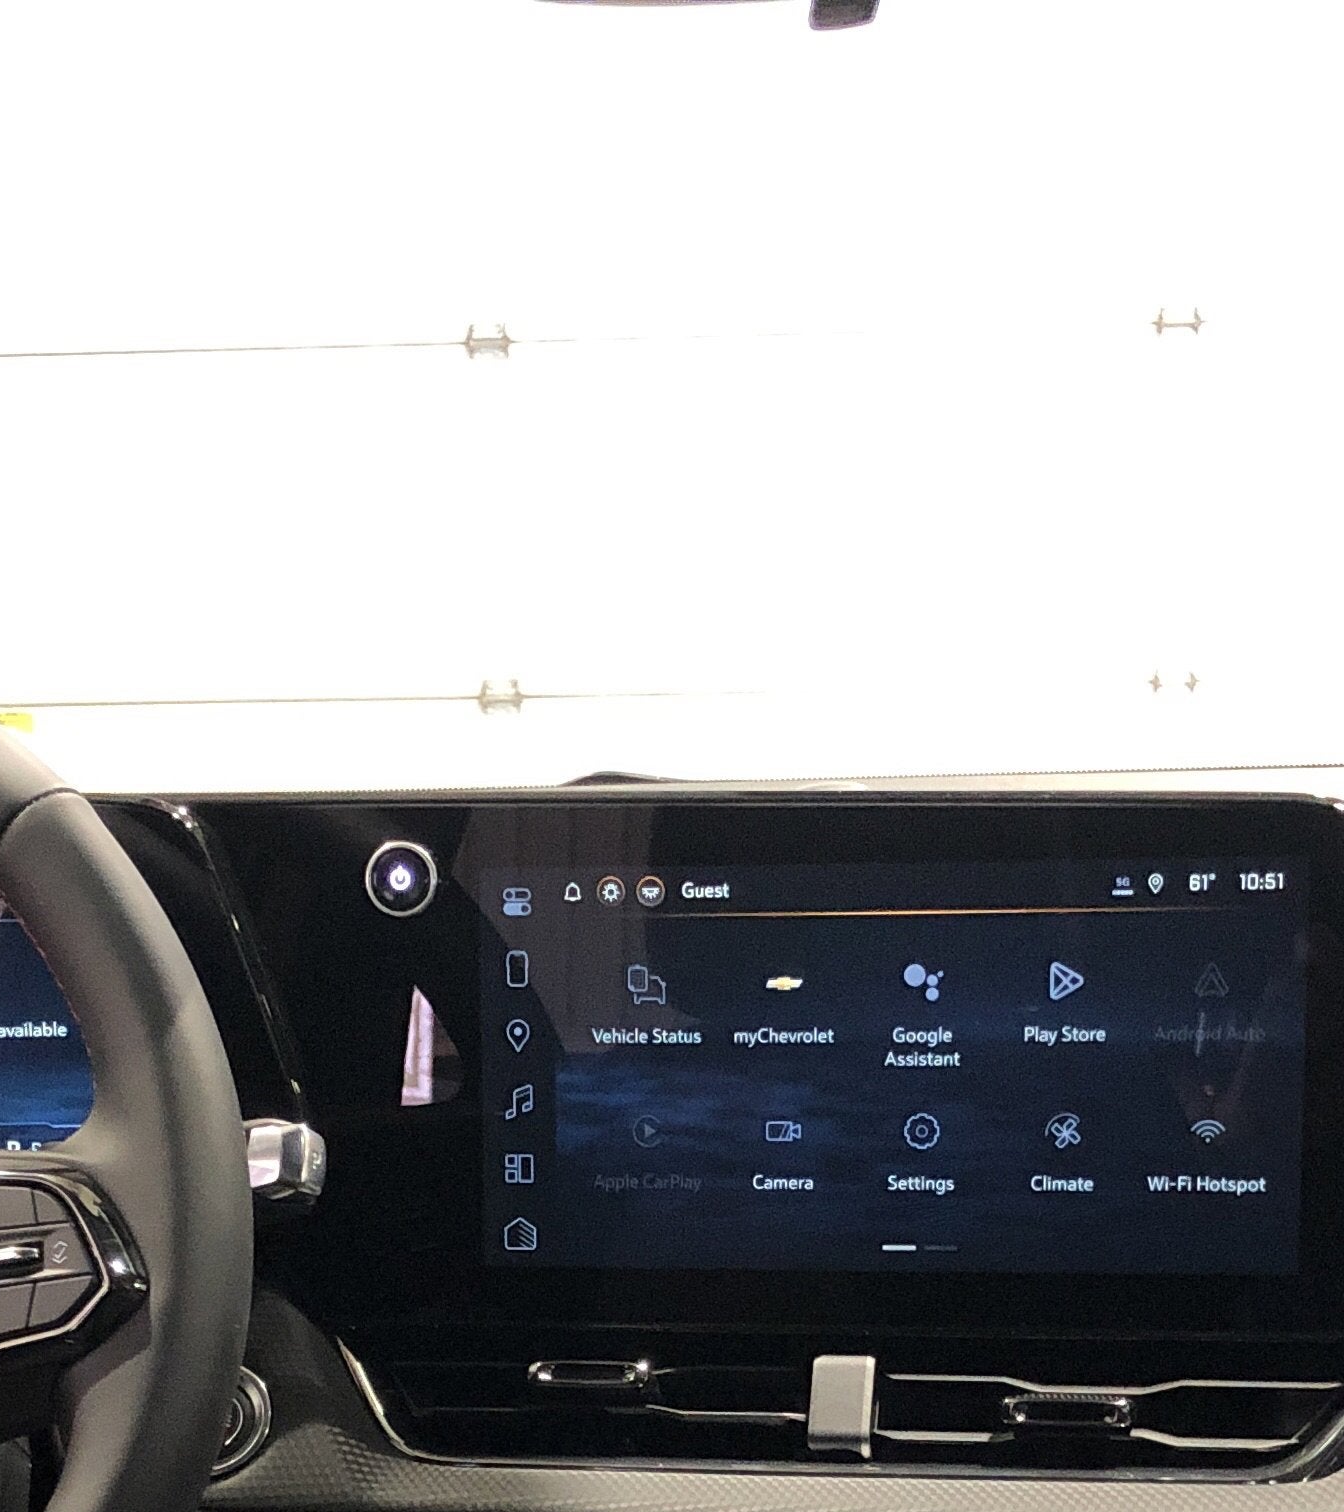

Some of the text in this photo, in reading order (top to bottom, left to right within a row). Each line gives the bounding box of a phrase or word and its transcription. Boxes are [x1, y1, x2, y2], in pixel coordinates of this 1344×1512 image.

[681, 881, 730, 898] Guest
[1239, 872, 1284, 890] 10:51
[592, 1027, 702, 1044] Vehicle Status
[733, 1027, 834, 1048] myChevrolet
[892, 1026, 952, 1047] Google
[1023, 1026, 1106, 1046] Play Store
[884, 1051, 961, 1067] Assistant
[593, 1174, 703, 1193] Apple CarPlay
[752, 1174, 814, 1191] Camera
[887, 1175, 955, 1195] Settings
[1031, 1175, 1094, 1192] Climate
[1147, 1175, 1267, 1196] Wi-Fi Hotspot
